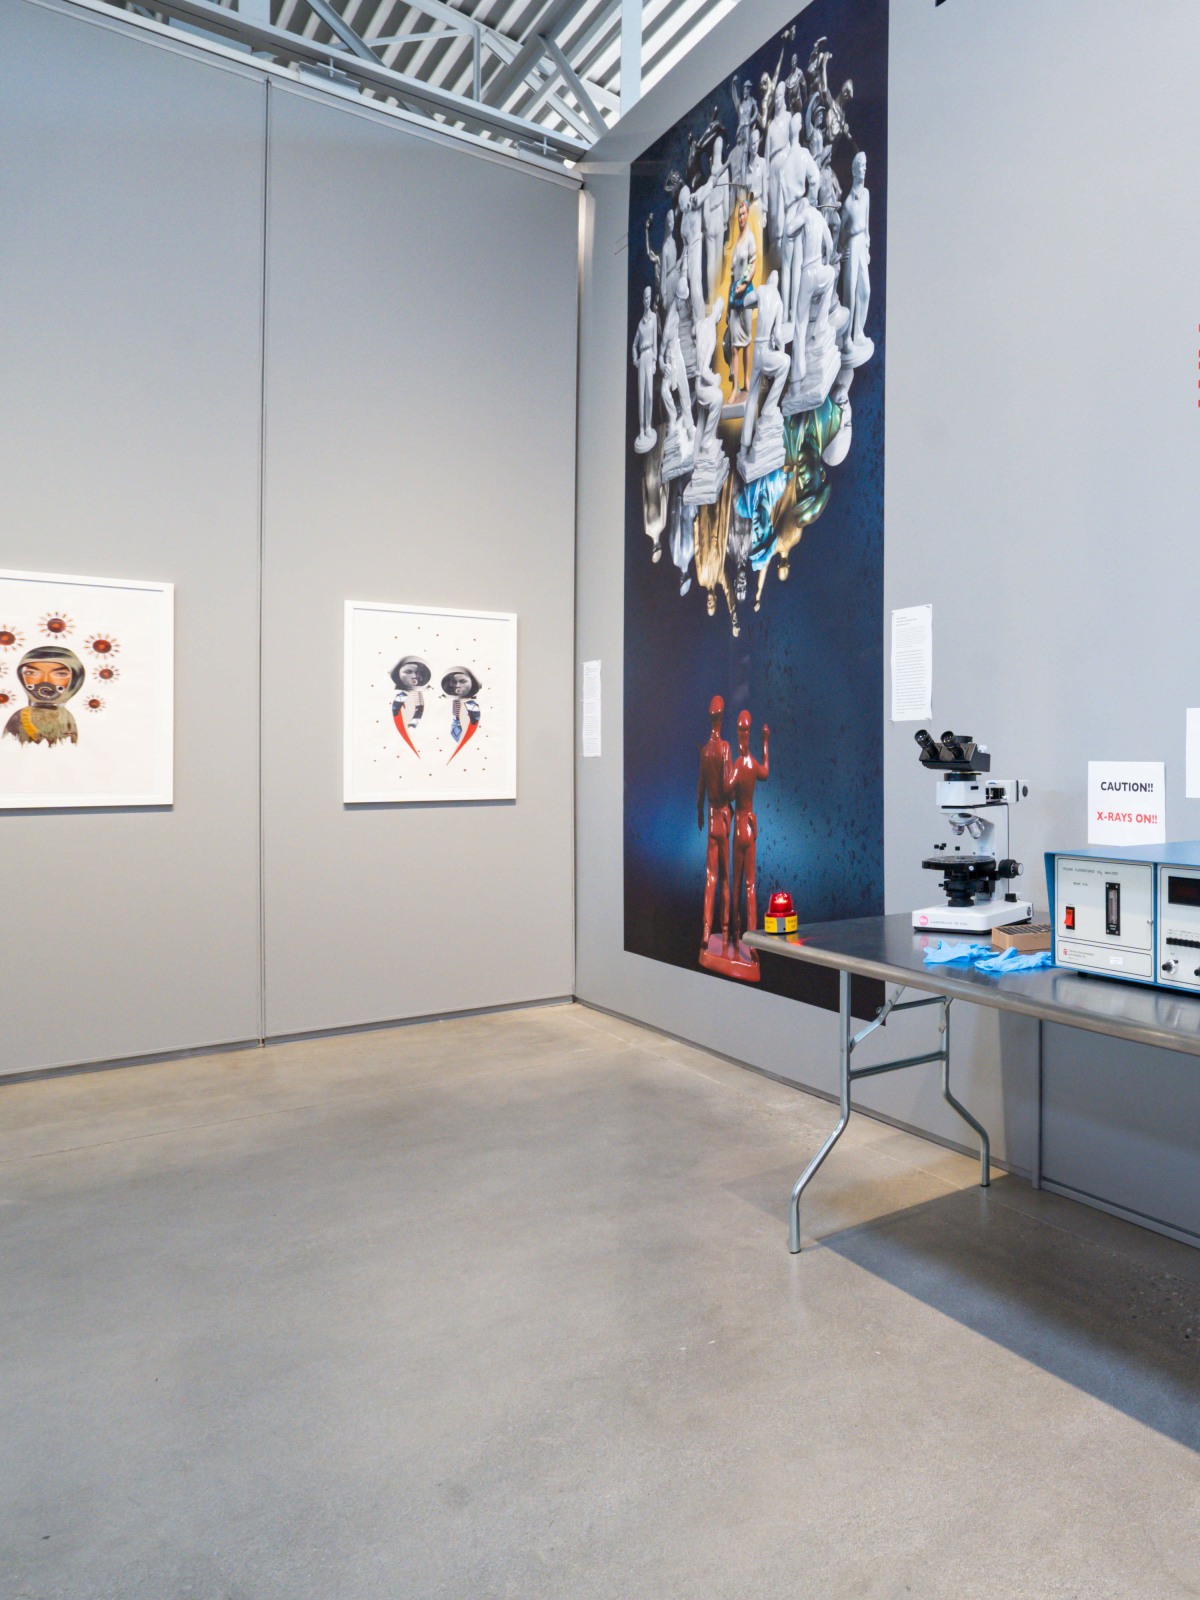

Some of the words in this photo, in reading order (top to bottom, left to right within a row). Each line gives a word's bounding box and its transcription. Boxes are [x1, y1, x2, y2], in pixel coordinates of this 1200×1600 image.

[1100, 781, 1154, 793] CAUTION!!
[1096, 811, 1133, 823] X-RAYS
[1135, 813, 1158, 824] ON!!
